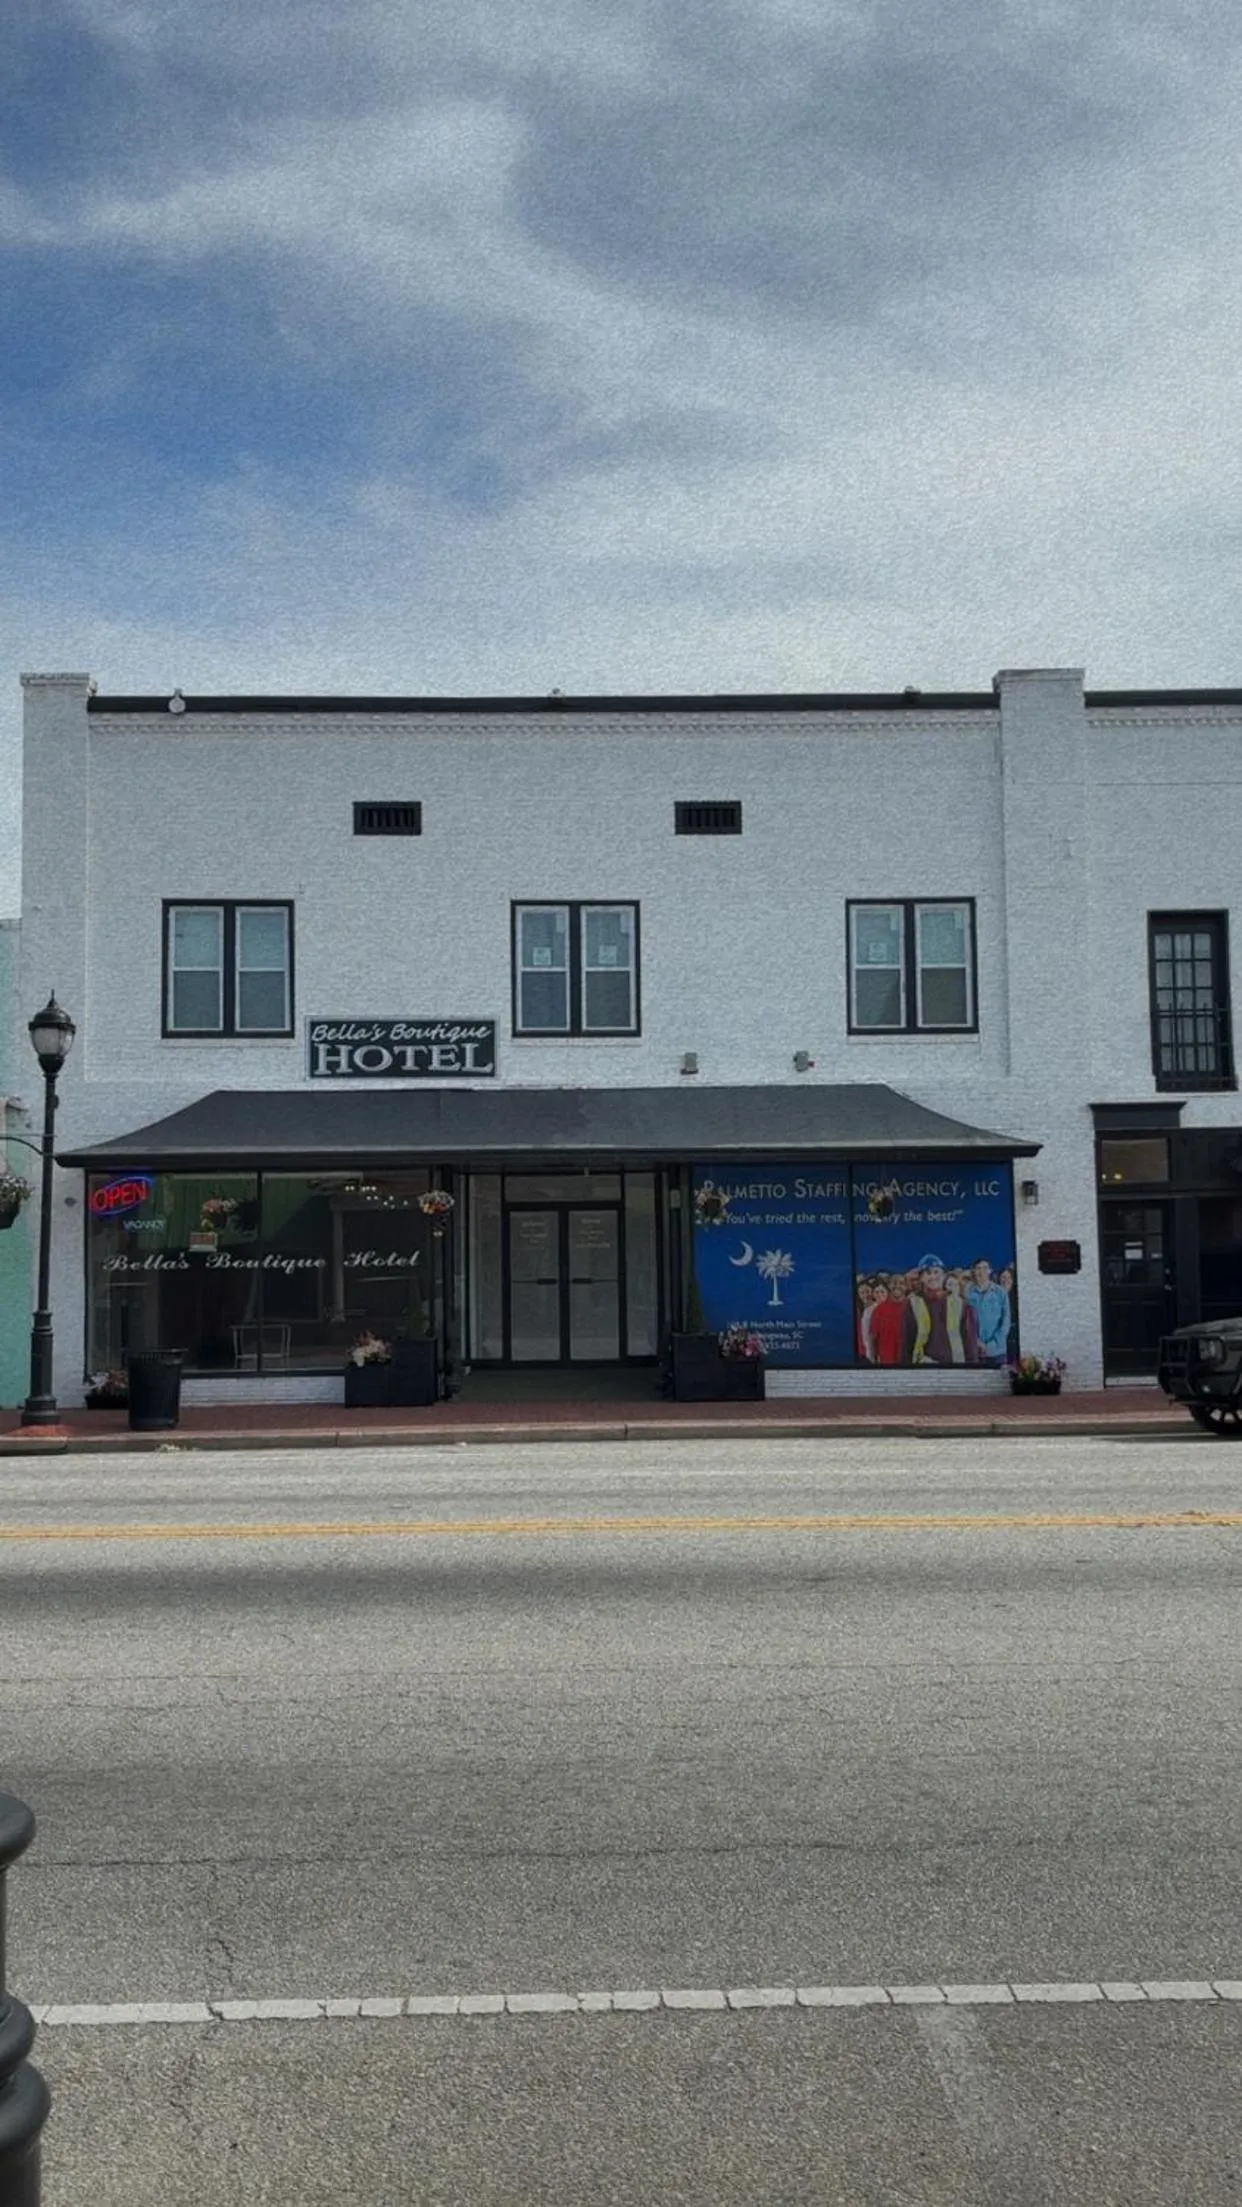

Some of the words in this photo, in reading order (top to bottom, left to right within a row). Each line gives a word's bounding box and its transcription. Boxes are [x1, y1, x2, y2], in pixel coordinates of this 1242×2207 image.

[311, 1023, 386, 1042] Bella's
[390, 1022, 493, 1043] Boutique
[313, 1043, 494, 1075] HOTEL
[91, 1180, 147, 1211] OPEN
[974, 1180, 1001, 1197] LLC
[765, 1211, 794, 1225] tried
[796, 1211, 816, 1225] the
[820, 1212, 846, 1225] rest,
[903, 1209, 923, 1222] the
[102, 1252, 190, 1271] Bella's
[205, 1252, 326, 1275] Boutique
[343, 1250, 420, 1268] Hotel
